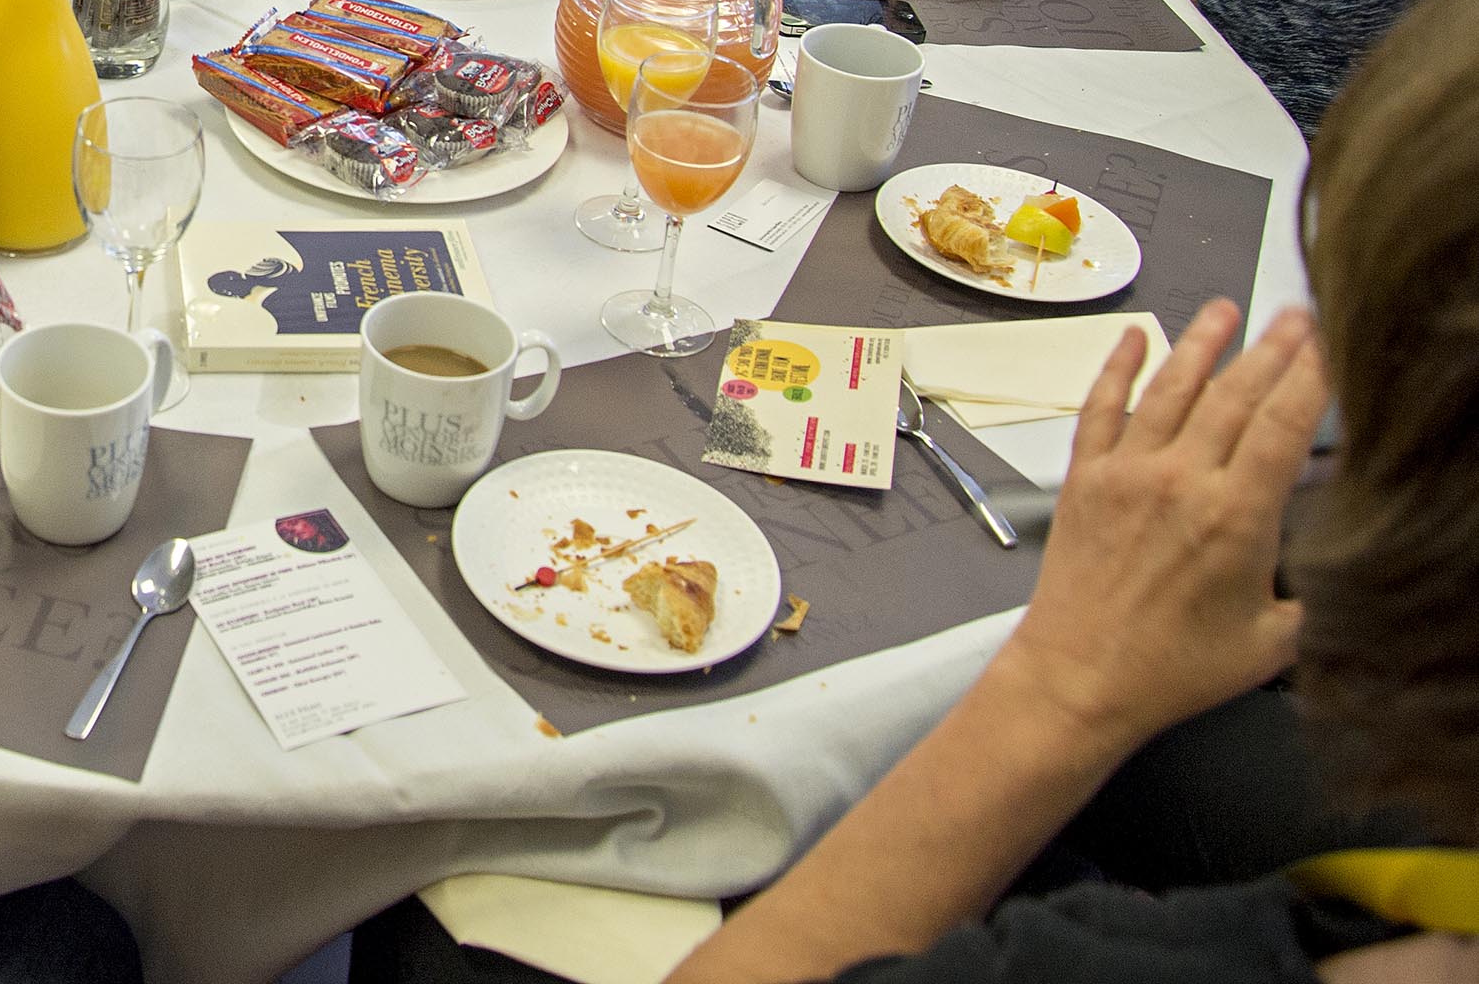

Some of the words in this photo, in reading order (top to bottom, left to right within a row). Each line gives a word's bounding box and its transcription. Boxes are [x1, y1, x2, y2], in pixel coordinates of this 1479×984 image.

[348, 3, 419, 33] VONDELMOLEN
[293, 34, 366, 68] VONDELMOLEN
[346, 259, 382, 309] French
[384, 399, 462, 432] PLUS
